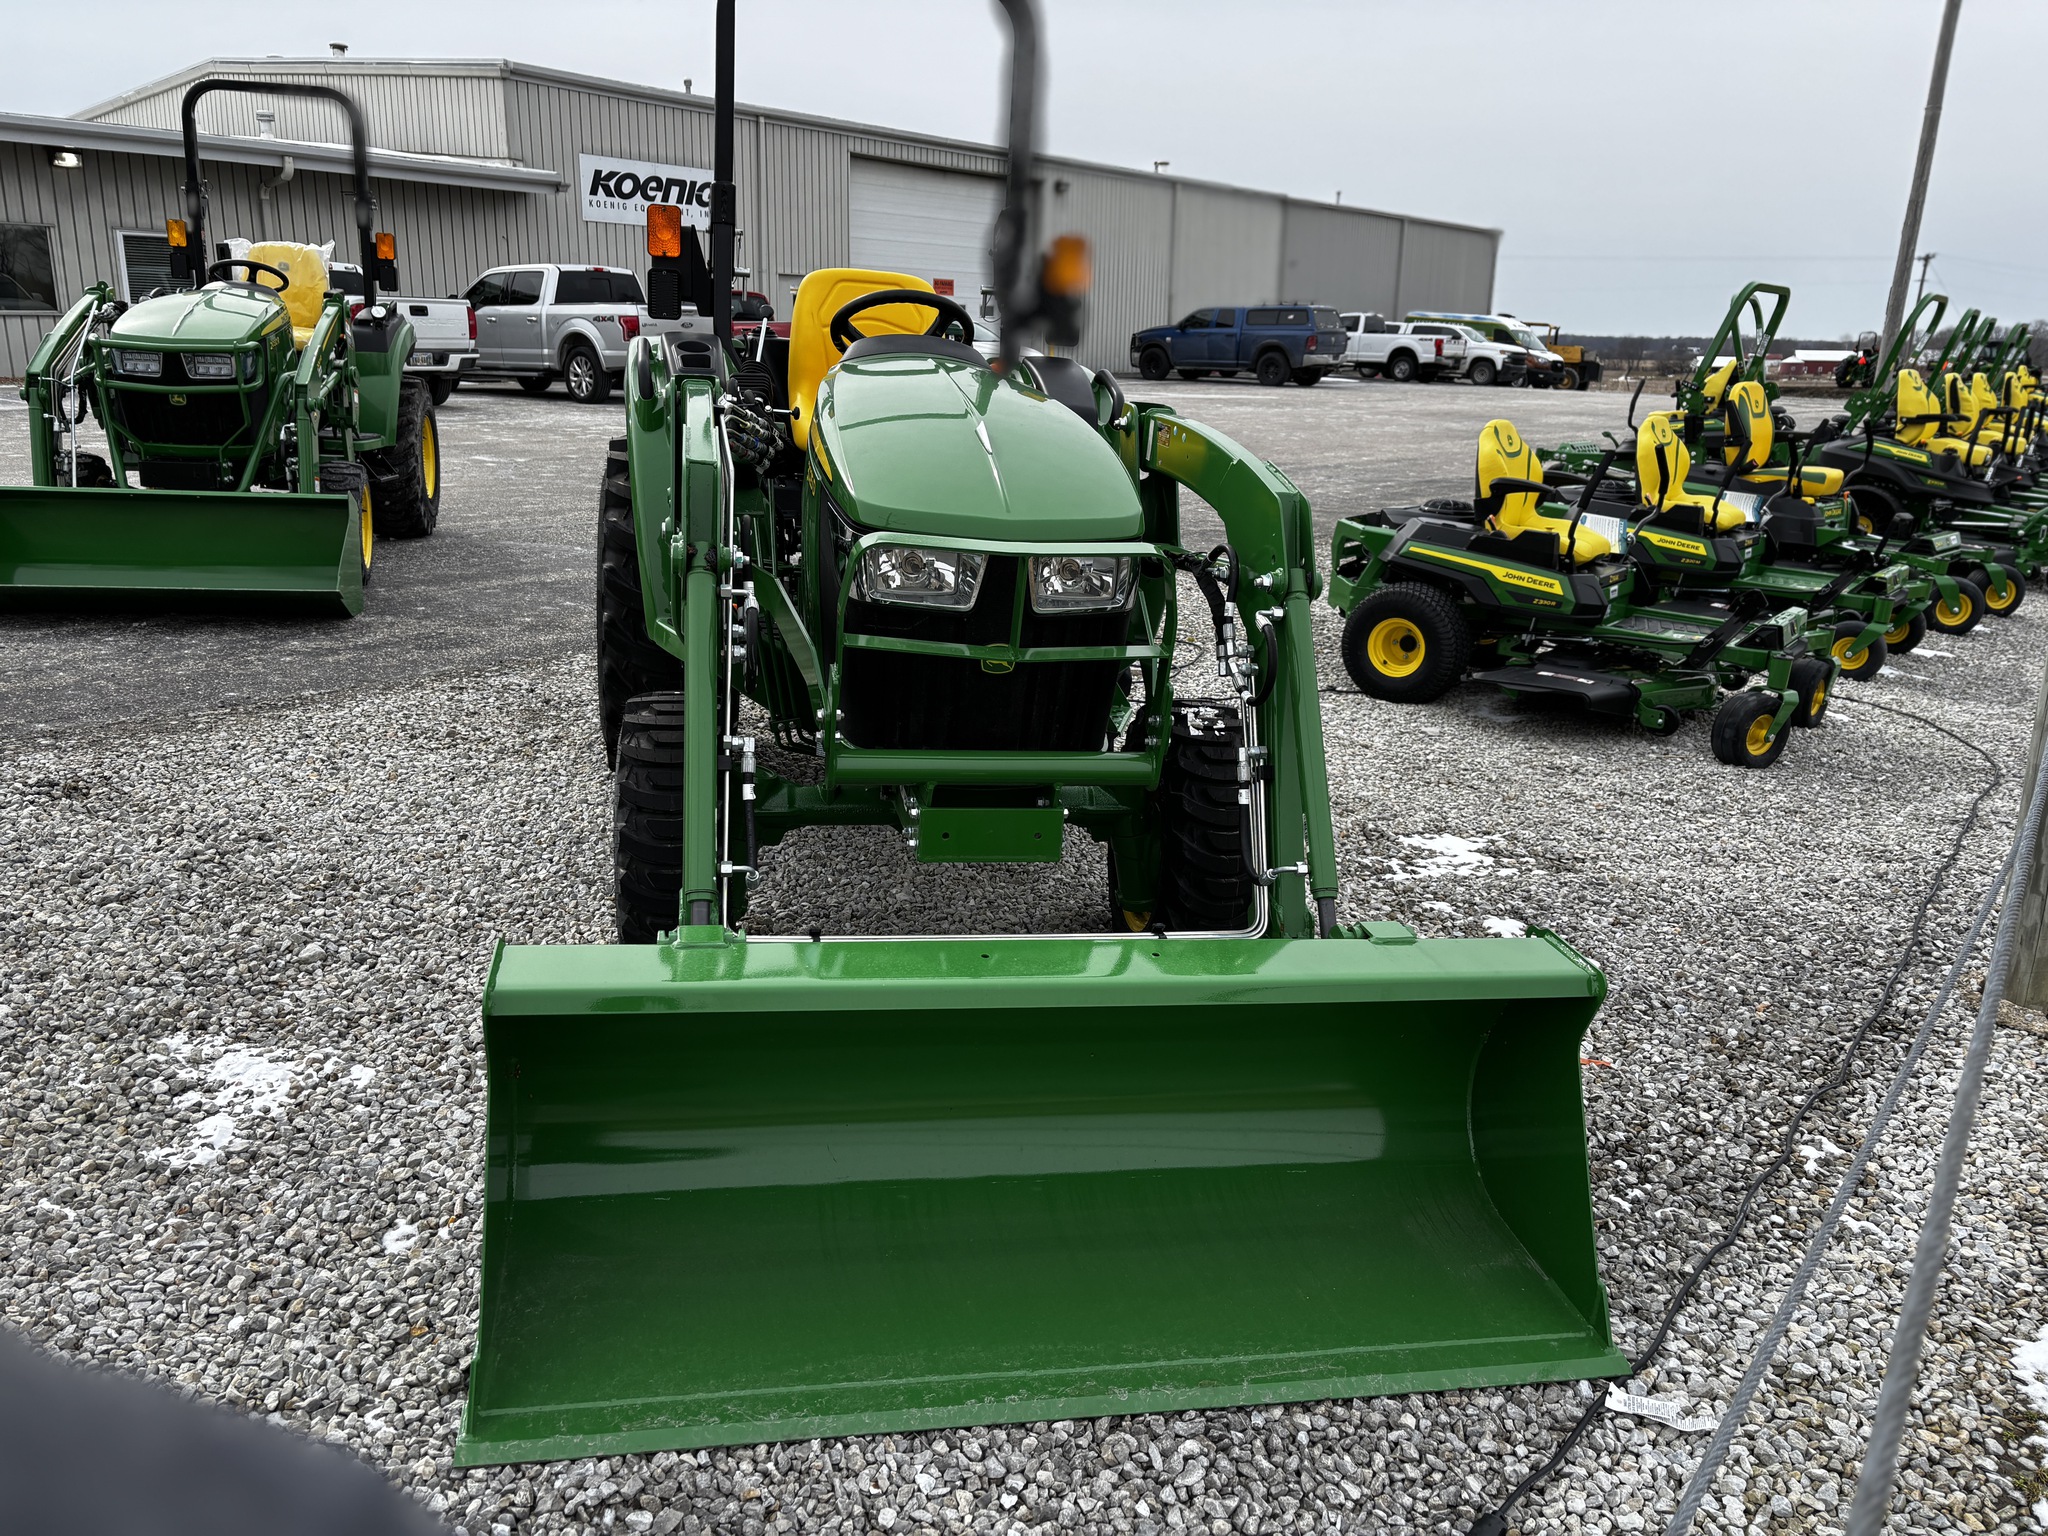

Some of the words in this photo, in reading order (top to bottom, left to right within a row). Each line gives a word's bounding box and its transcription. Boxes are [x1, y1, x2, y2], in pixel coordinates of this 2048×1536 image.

[588, 199, 627, 211] KOENIG
[1657, 537, 1676, 547] JOHN
[1676, 540, 1701, 551] DEERE
[1502, 571, 1526, 582] JOHN
[1526, 576, 1556, 589] DEERE
